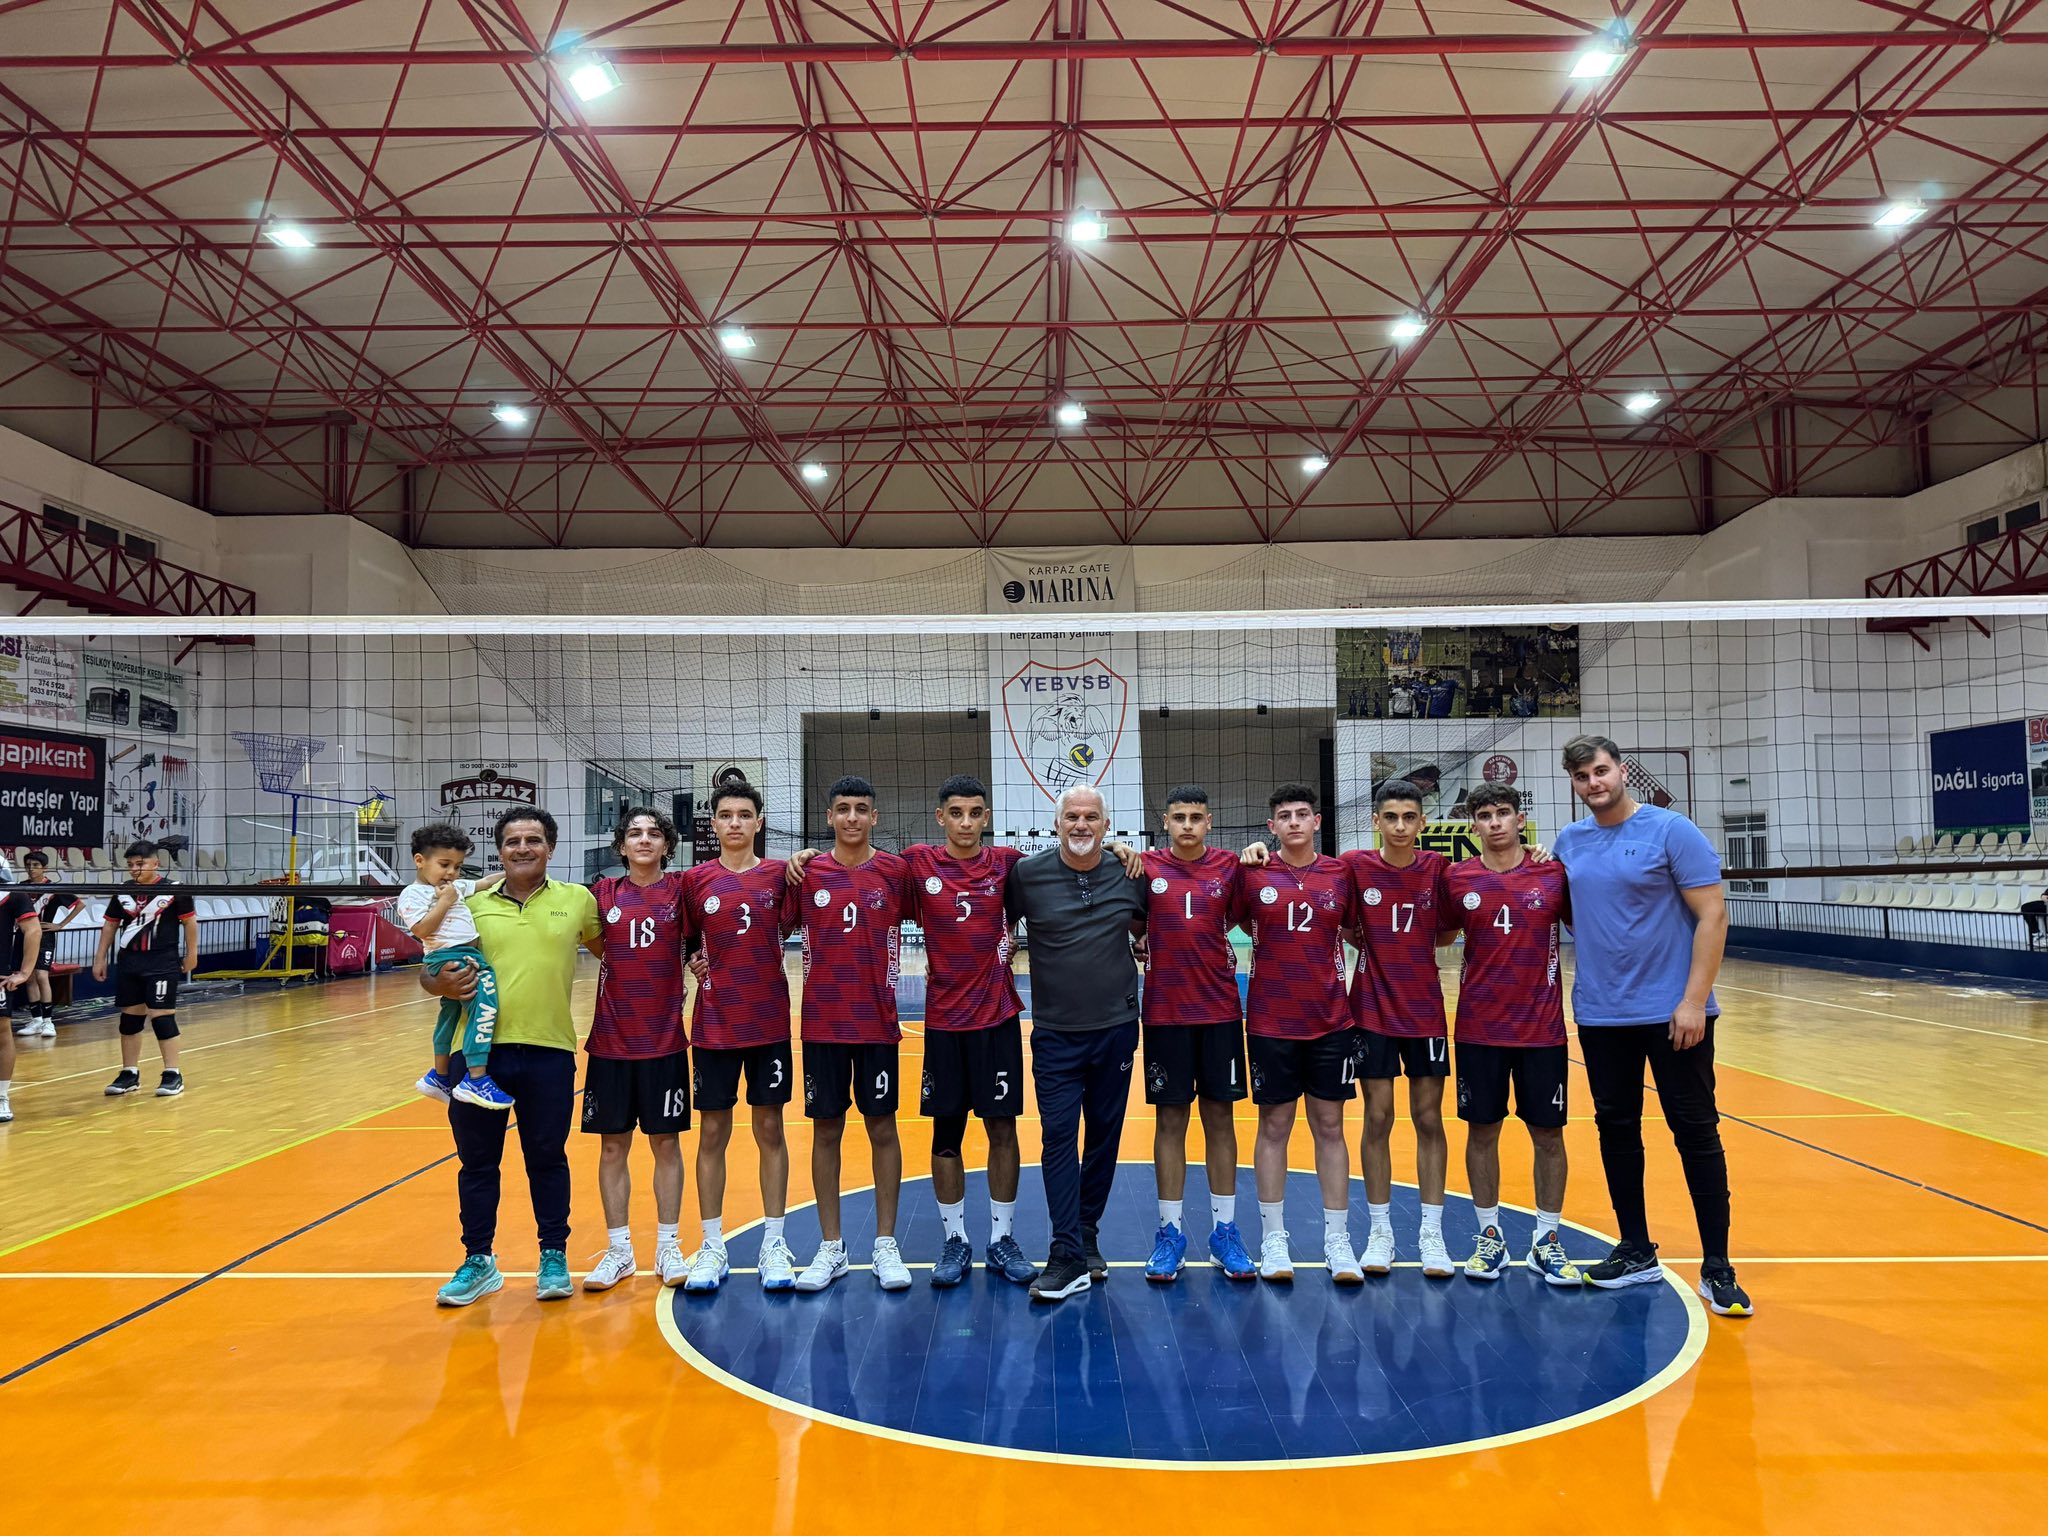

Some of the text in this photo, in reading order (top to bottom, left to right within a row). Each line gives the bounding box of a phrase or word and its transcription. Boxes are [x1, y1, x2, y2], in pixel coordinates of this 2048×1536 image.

[1028, 564, 1111, 575] KARPAZ GATE
[1028, 576, 1116, 603] MARINA
[1030, 631, 1066, 640] zaman
[1020, 674, 1111, 692] YEBVSB
[444, 783, 534, 803] KARPAZ
[1933, 766, 2024, 792] DAĞLI sigorta
[23, 815, 74, 837] Market
[469, 827, 494, 838] zey
[736, 902, 751, 935] 3
[842, 901, 858, 933] 9
[955, 891, 972, 922] 5
[1185, 890, 1193, 919] 1
[1287, 901, 1314, 932] 12
[1391, 902, 1415, 933] 17
[1493, 903, 1513, 935] 4
[629, 916, 656, 949] 18
[155, 980, 168, 995] 11
[888, 960, 898, 988] GROUP
[475, 1003, 498, 1044] PAW
[1428, 1036, 1446, 1062] 17
[768, 1058, 783, 1088] 3
[875, 1070, 889, 1099] 9
[994, 1071, 1009, 1100] 5
[1230, 1058, 1237, 1085] 1
[663, 1087, 684, 1118] 18
[1551, 1083, 1565, 1112] 4
